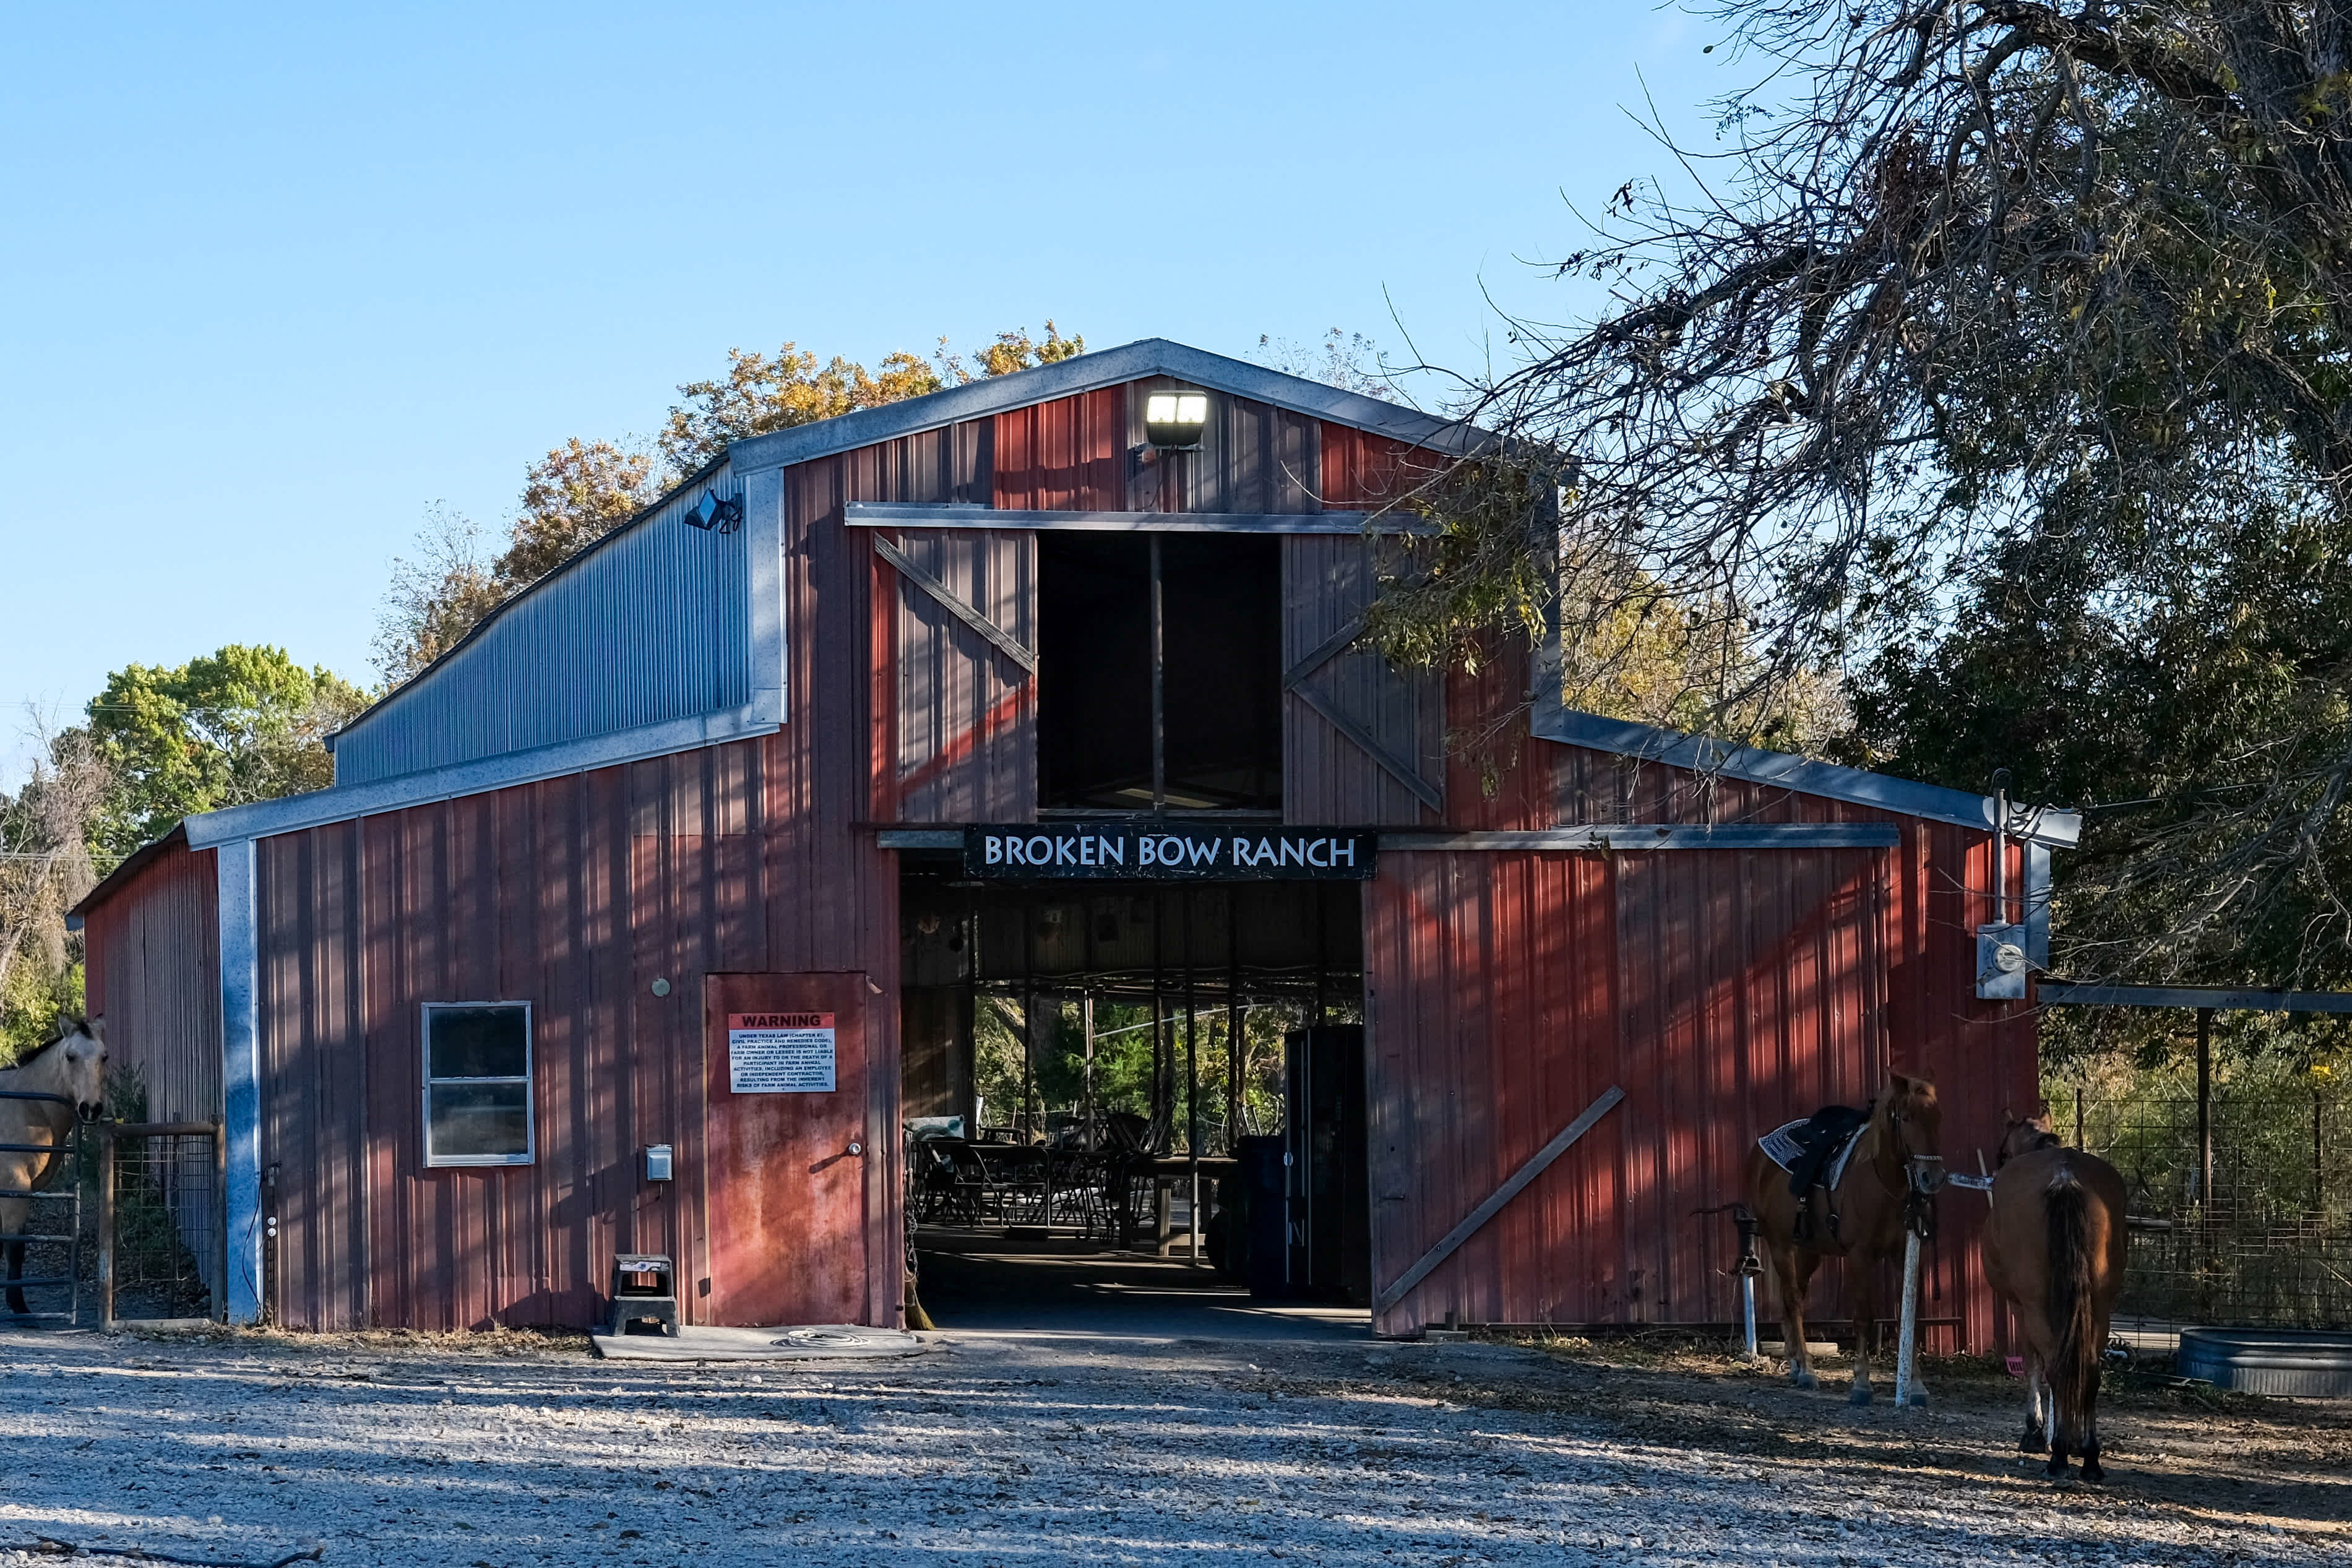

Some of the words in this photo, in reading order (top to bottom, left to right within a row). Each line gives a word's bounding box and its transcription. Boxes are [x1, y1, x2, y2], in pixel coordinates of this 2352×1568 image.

[984, 835, 1124, 865] BROKEN
[1139, 836, 1221, 866] BOW
[1233, 837, 1355, 867] RANCH
[743, 1015, 821, 1027] WARNING
